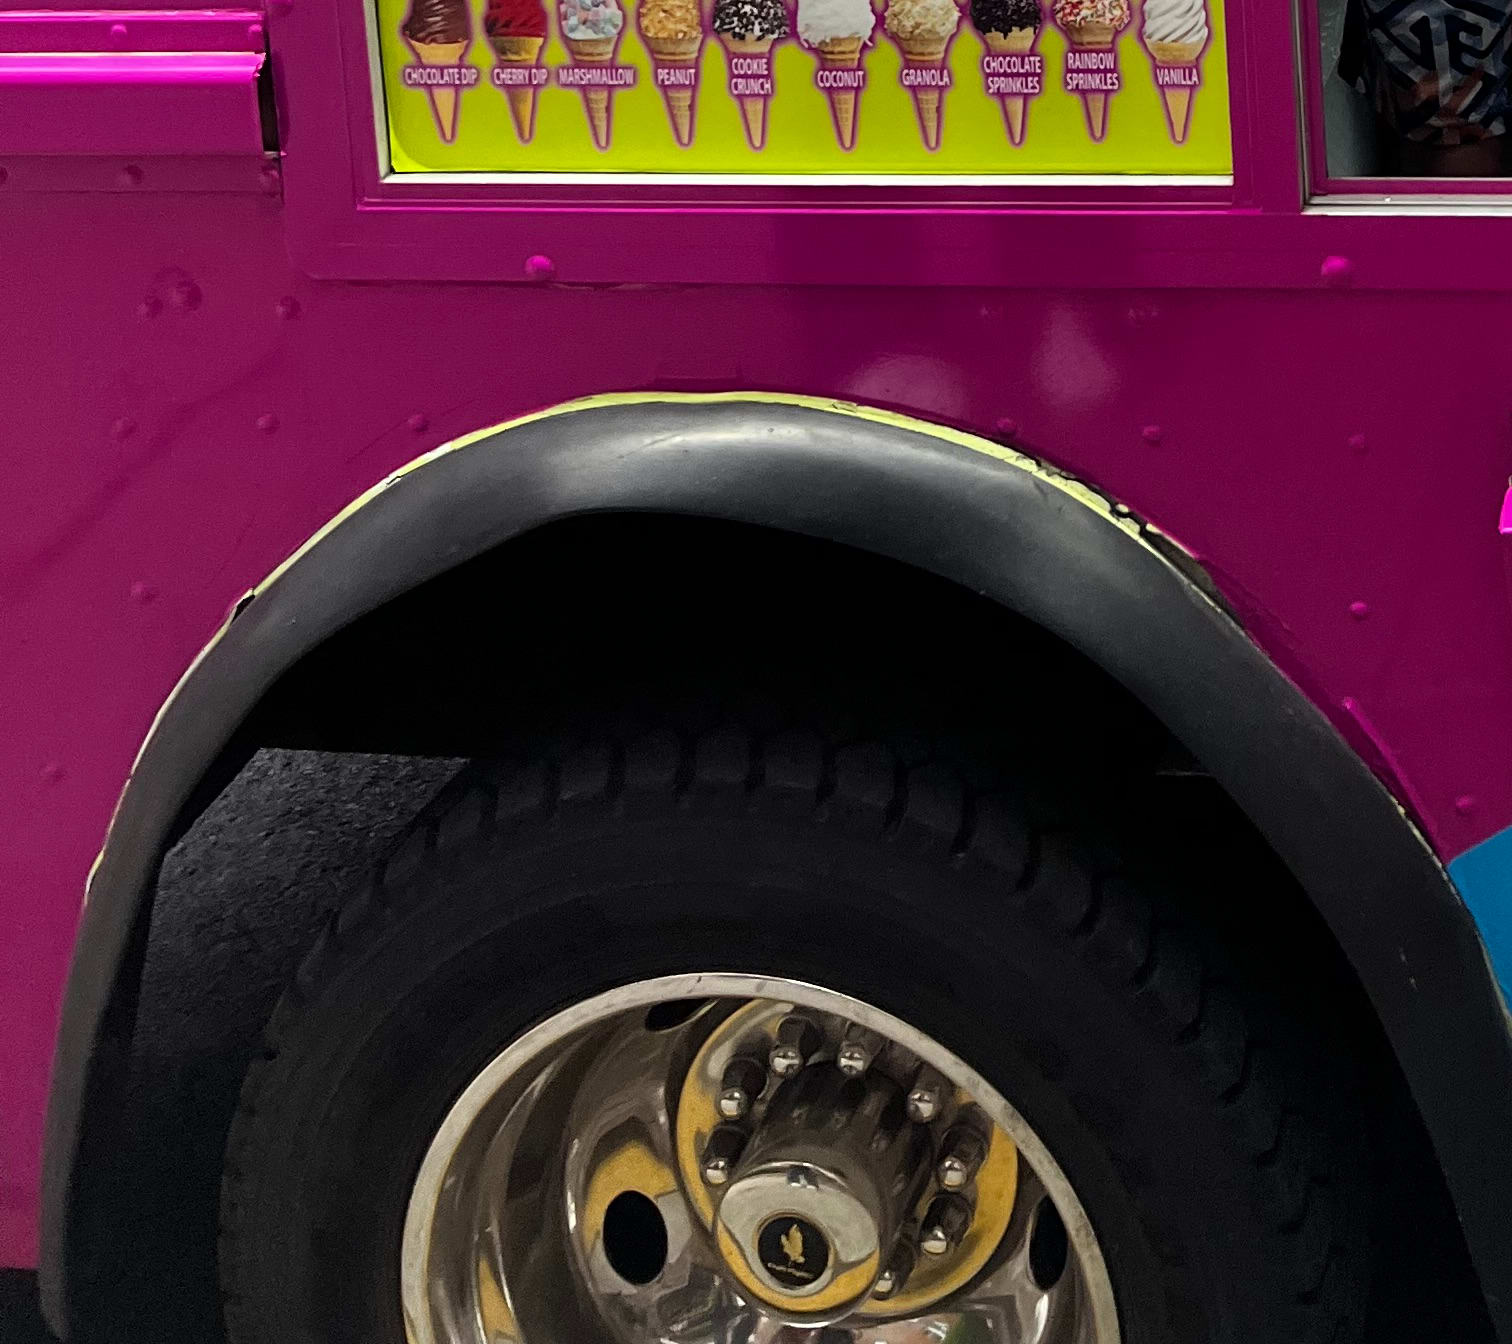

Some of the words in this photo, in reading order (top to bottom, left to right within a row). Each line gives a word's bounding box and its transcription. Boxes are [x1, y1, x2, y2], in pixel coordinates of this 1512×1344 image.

[731, 58, 768, 75] COOKIE
[983, 56, 1042, 74] CHOCOLATE
[1067, 52, 1115, 70] RAINBOW
[404, 68, 460, 85] CHOCOLATE
[461, 68, 478, 85] DIP
[494, 68, 530, 85] CHERRY
[531, 68, 548, 85] DIP
[559, 68, 634, 85] MARSHMALLOW
[657, 68, 696, 86] PEANUT
[817, 70, 865, 88] COCONUT
[901, 69, 950, 86] GRANOLA
[987, 76, 1040, 94] SPRINKLES
[1066, 73, 1119, 91] SPRINKLES
[1156, 68, 1199, 86] VANILLA
[731, 78, 772, 95] CRUNCH
